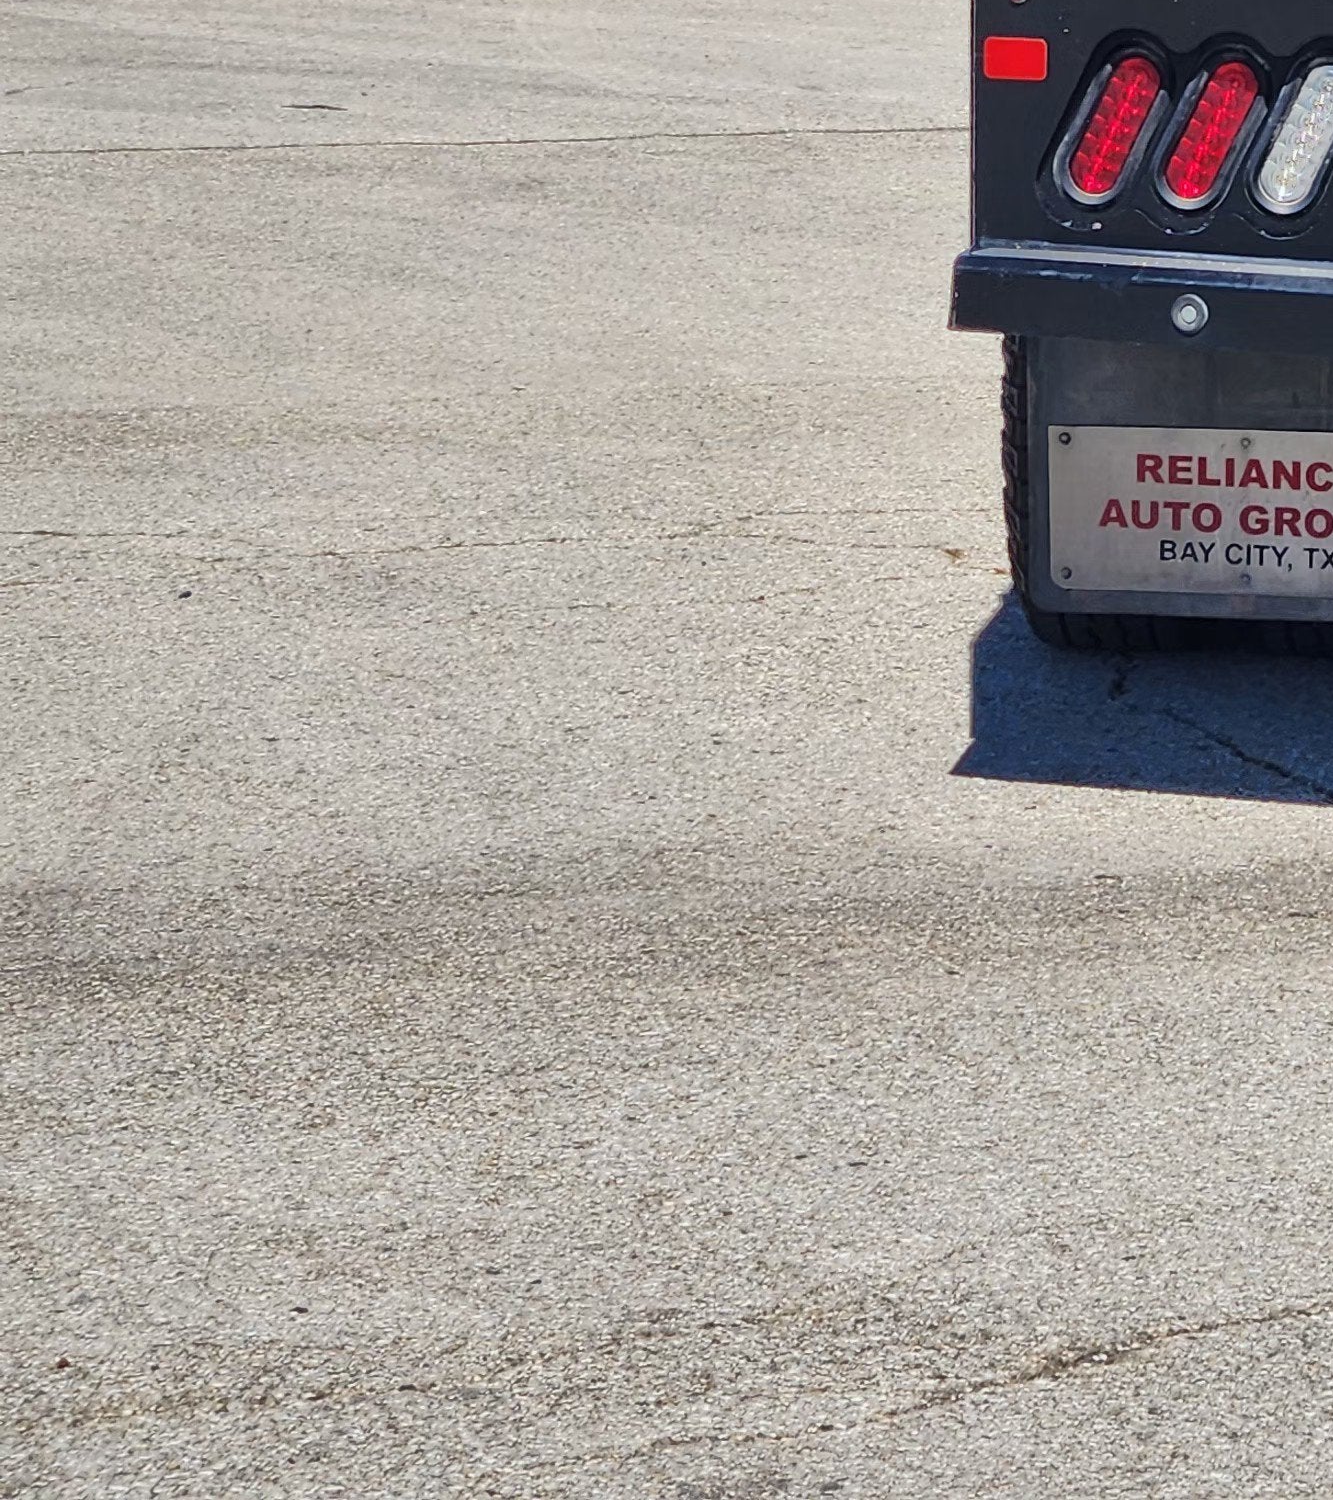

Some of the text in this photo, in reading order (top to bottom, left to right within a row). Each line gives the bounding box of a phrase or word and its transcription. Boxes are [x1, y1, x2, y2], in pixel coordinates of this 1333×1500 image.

[1099, 498, 1222, 533] AUTO
[1159, 539, 1213, 563] BAY
[1225, 543, 1293, 572] CITY,
